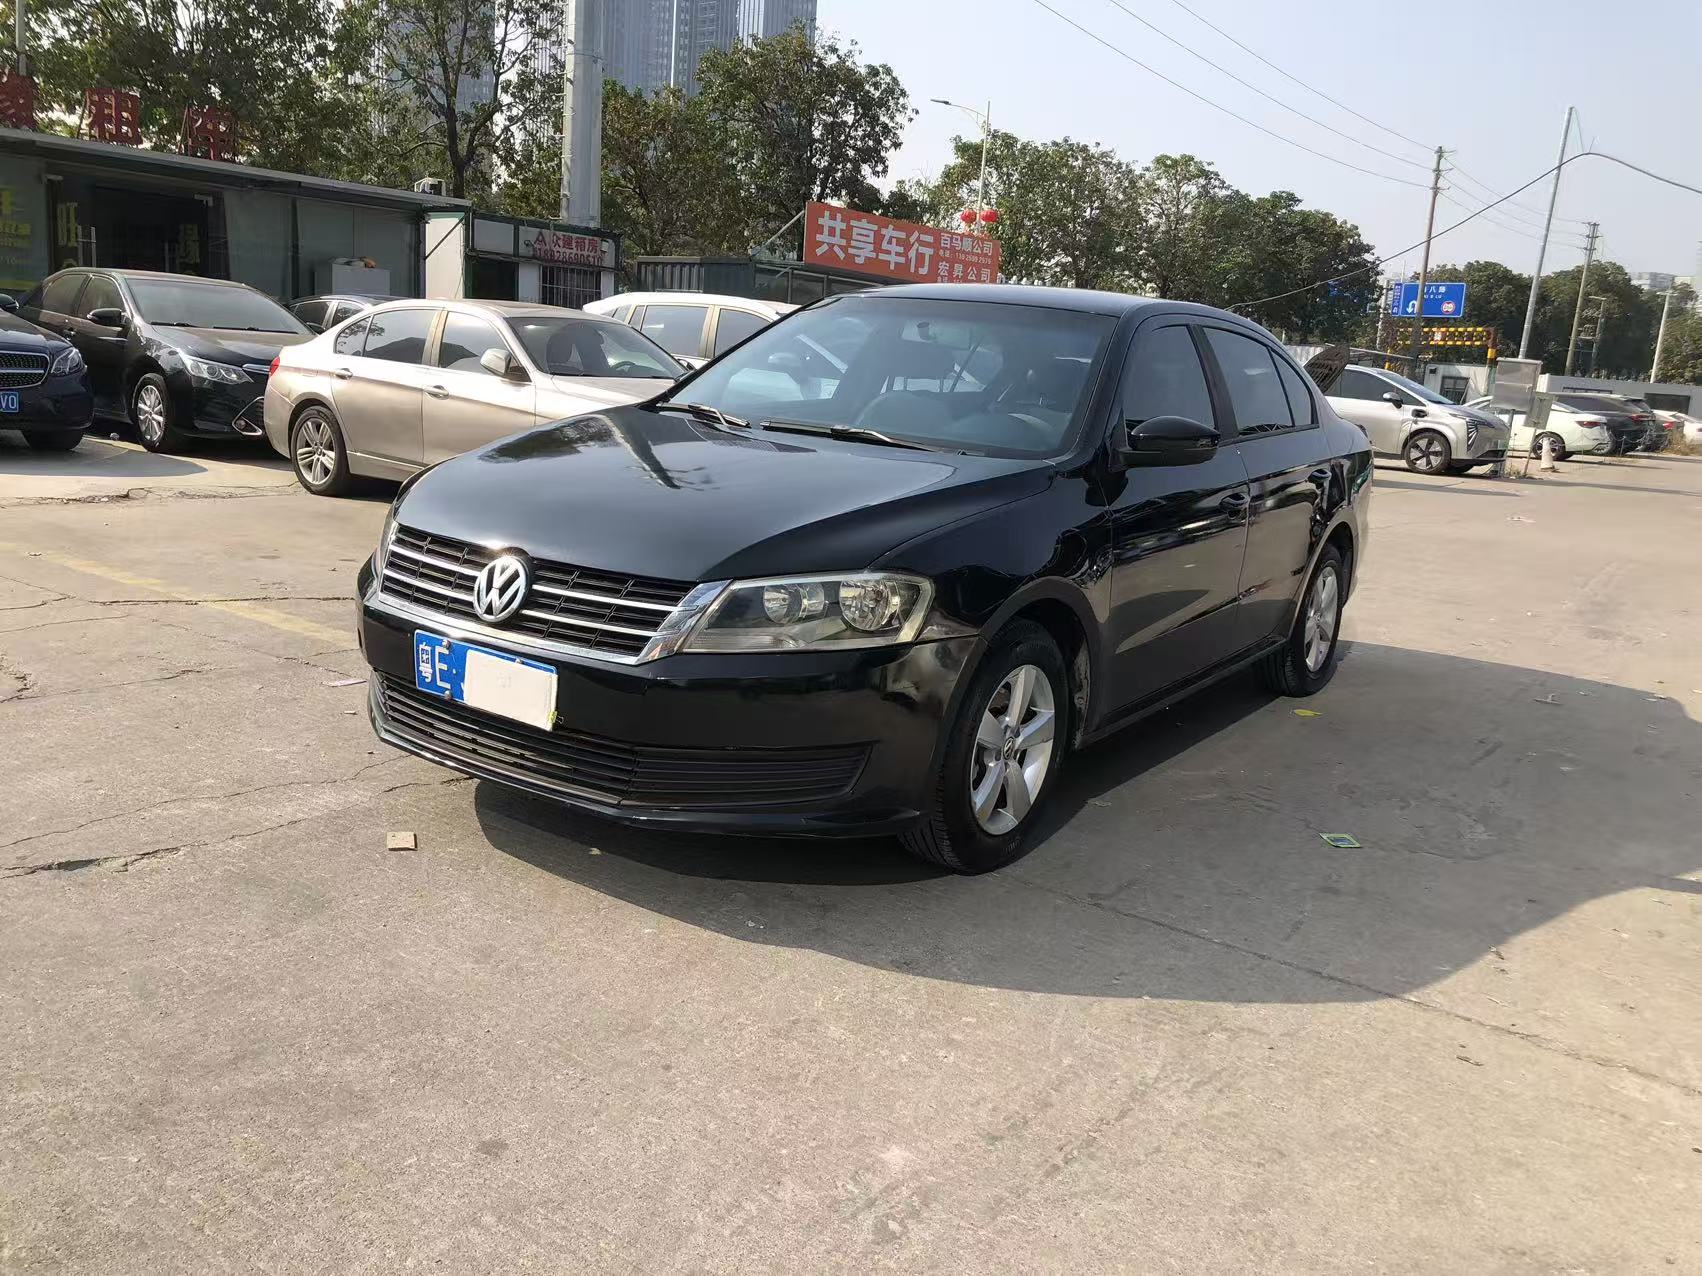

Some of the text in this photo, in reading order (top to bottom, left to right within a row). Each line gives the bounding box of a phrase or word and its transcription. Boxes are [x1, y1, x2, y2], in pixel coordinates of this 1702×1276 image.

[815, 210, 934, 275] 共享车行
[940, 232, 993, 256] 百马顺公司
[474, 556, 527, 622] VW
